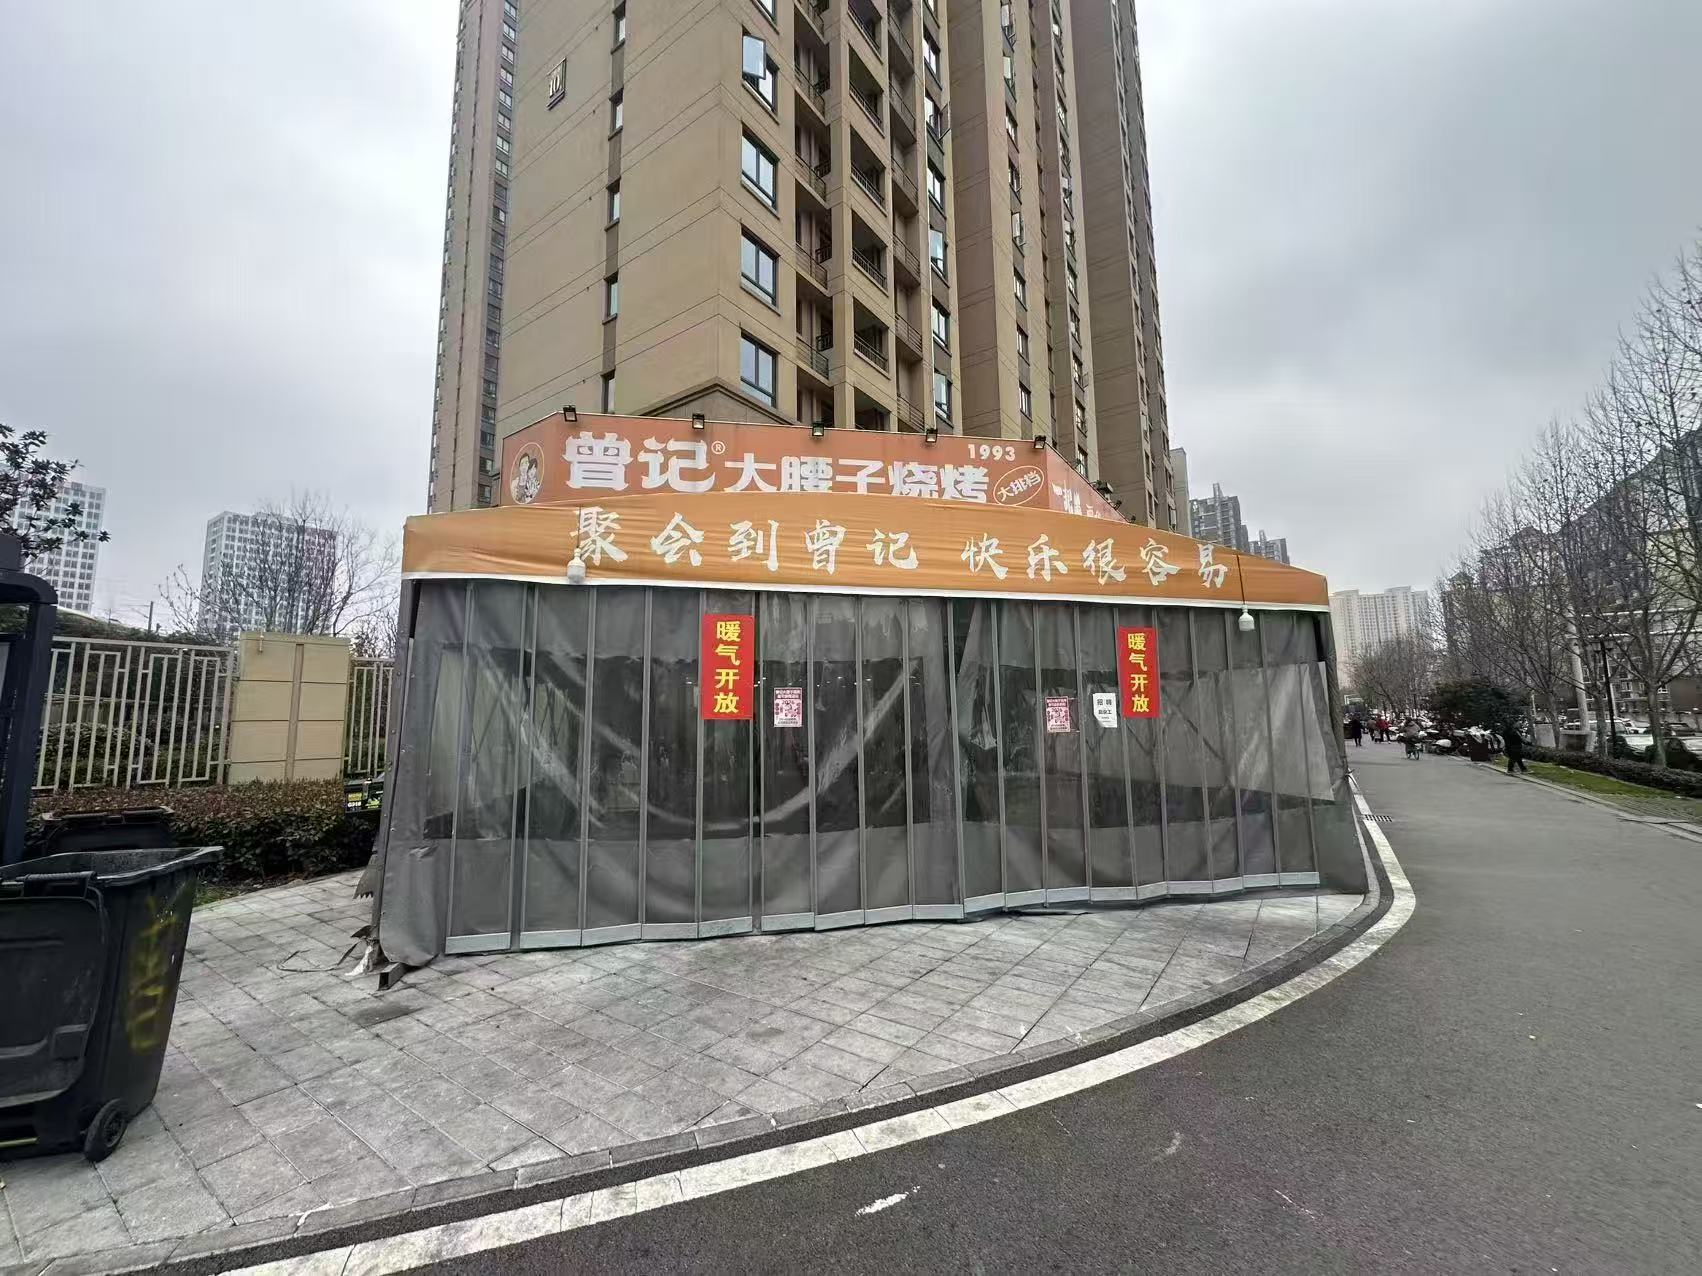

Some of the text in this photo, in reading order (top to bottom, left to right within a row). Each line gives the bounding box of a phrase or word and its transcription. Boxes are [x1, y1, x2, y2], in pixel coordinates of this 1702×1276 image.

[562, 430, 716, 493] 曾记
[724, 452, 989, 503] 大腰子烧烤
[968, 443, 1016, 461] 1993
[569, 506, 1228, 588] 聚会到曾记 快乐很容易
[713, 621, 741, 713] 暖气开放
[1127, 633, 1150, 713] 暖气开放
